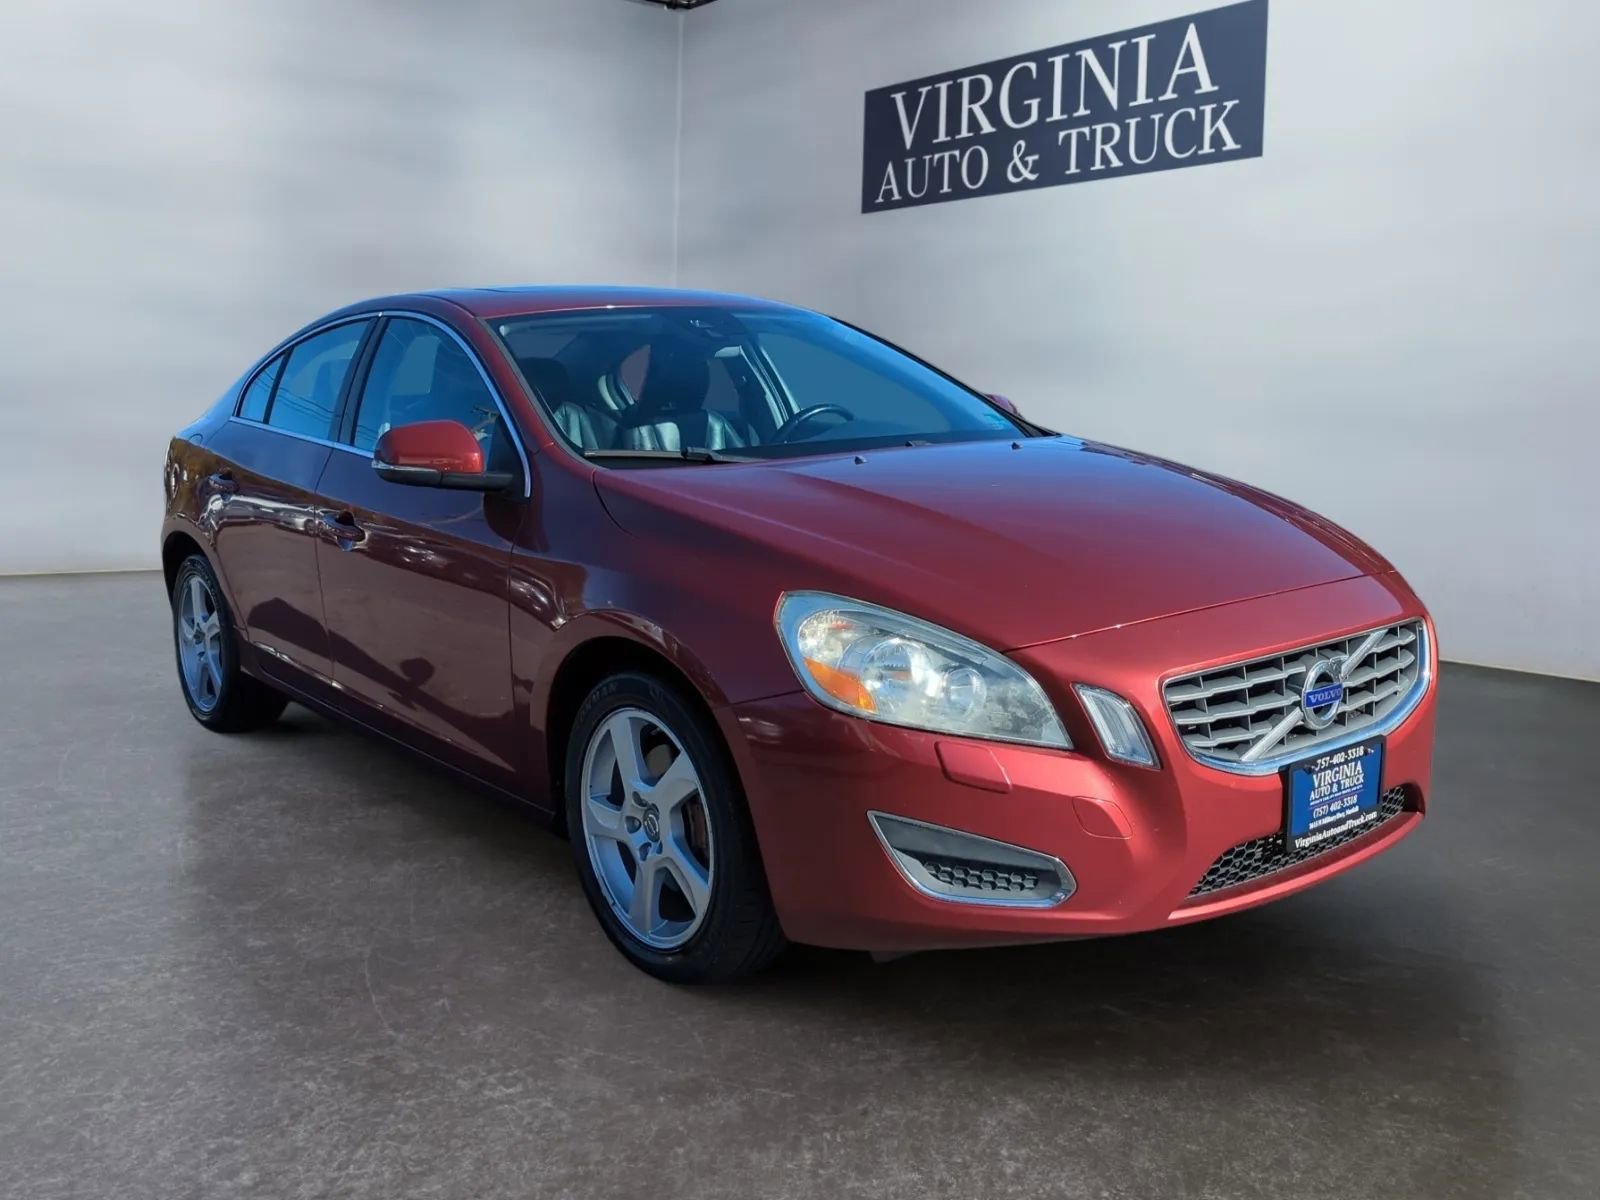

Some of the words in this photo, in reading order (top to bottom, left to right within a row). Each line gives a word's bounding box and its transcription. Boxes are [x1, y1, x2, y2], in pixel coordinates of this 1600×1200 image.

[890, 22, 1219, 151] VIRGINIA
[875, 145, 989, 203] AUTO
[1007, 139, 1040, 184] &
[1058, 100, 1241, 175] TRUCK
[1308, 688, 1341, 703] VOLVO
[1309, 785, 1331, 801] AUTO
[1332, 782, 1339, 793] &
[1340, 773, 1364, 790] TRUCK
[1313, 760, 1363, 788] VIRGINIA
